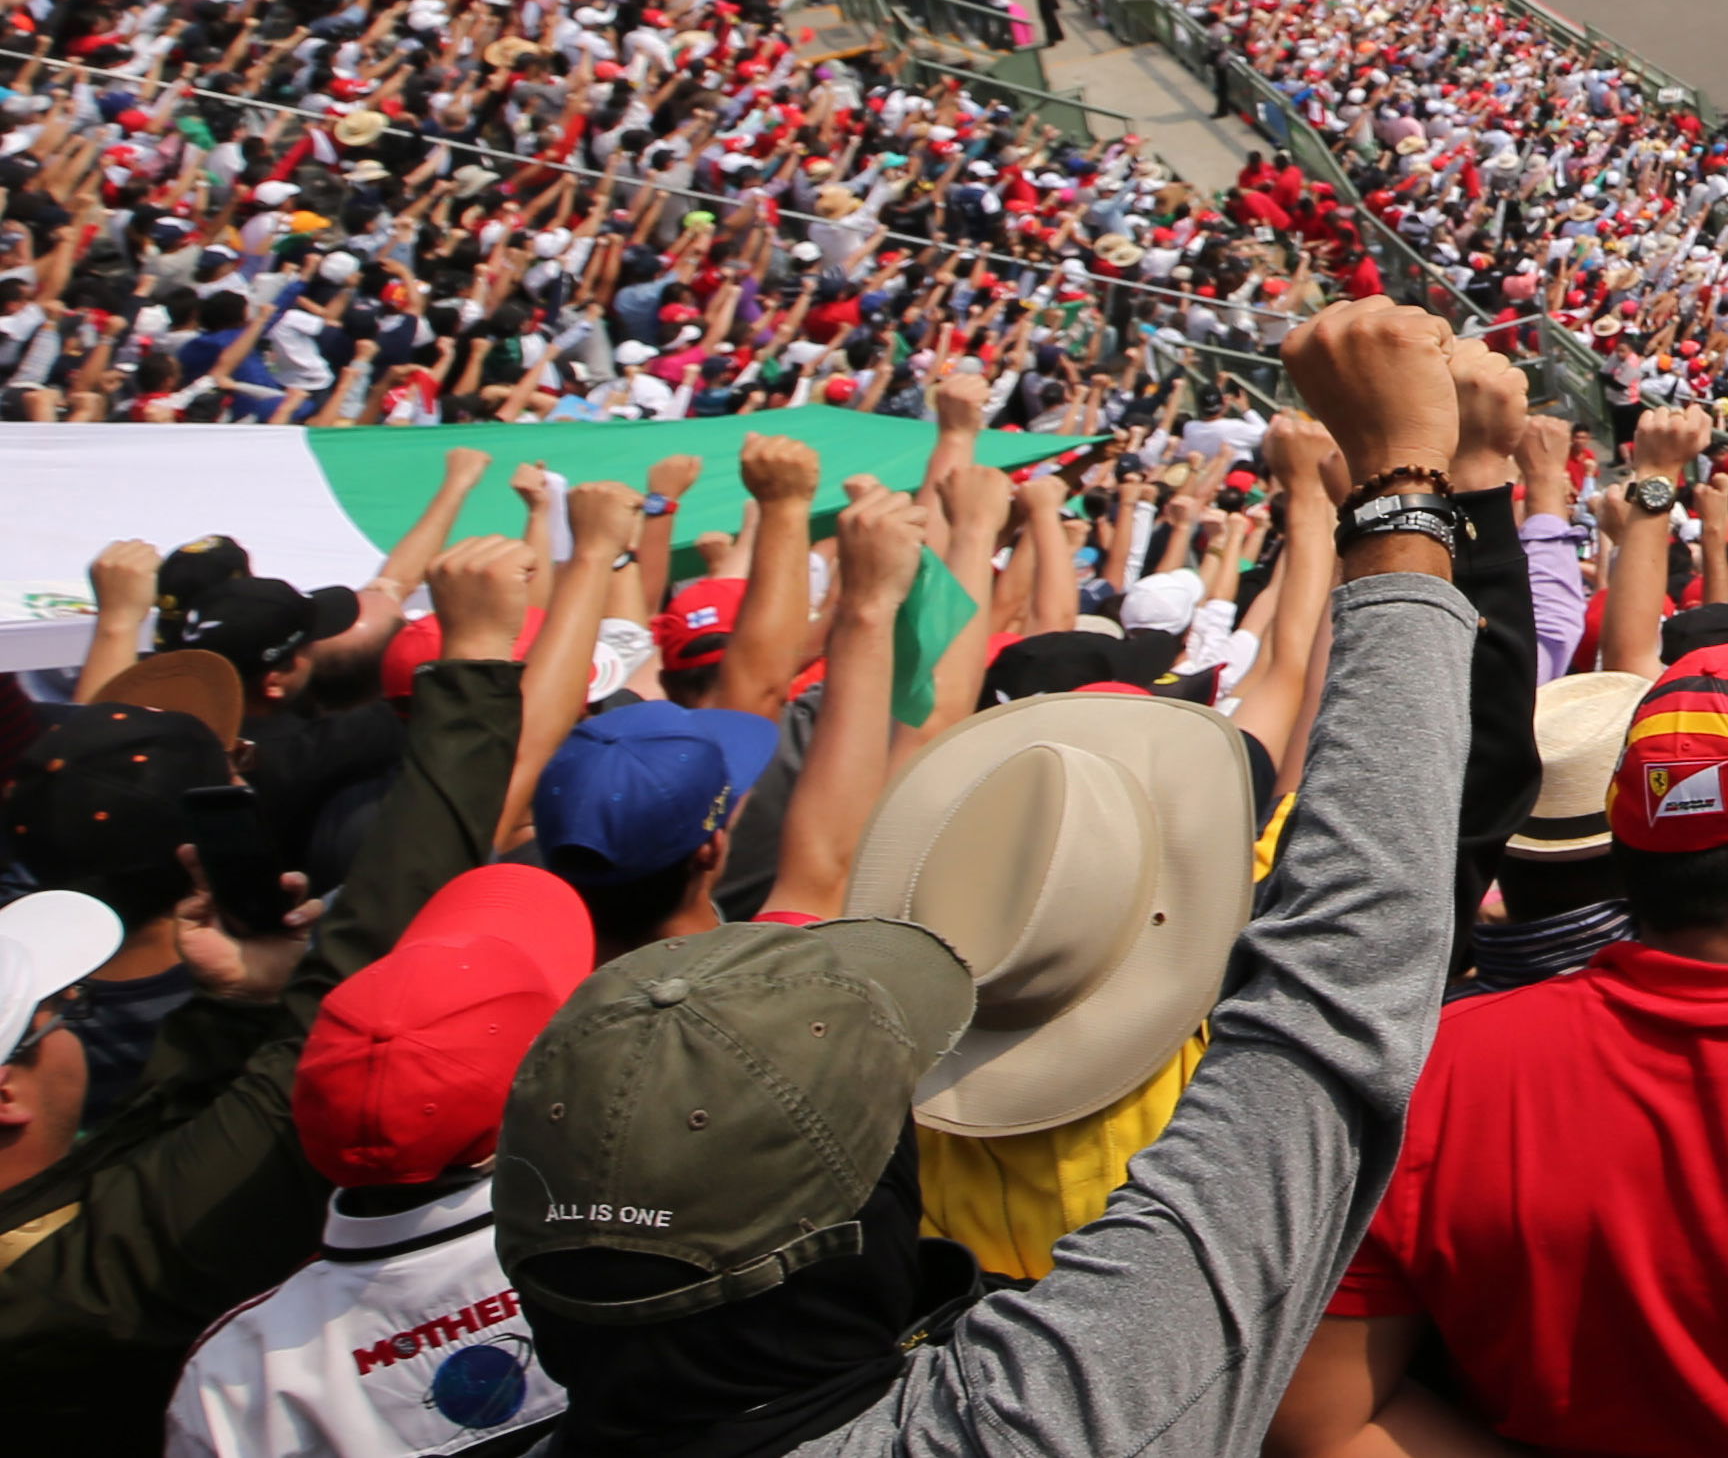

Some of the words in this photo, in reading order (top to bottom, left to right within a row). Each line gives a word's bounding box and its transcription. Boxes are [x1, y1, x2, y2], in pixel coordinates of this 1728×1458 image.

[545, 1204, 584, 1222] ALL
[590, 1204, 613, 1221] IS
[619, 1206, 673, 1227] ONE
